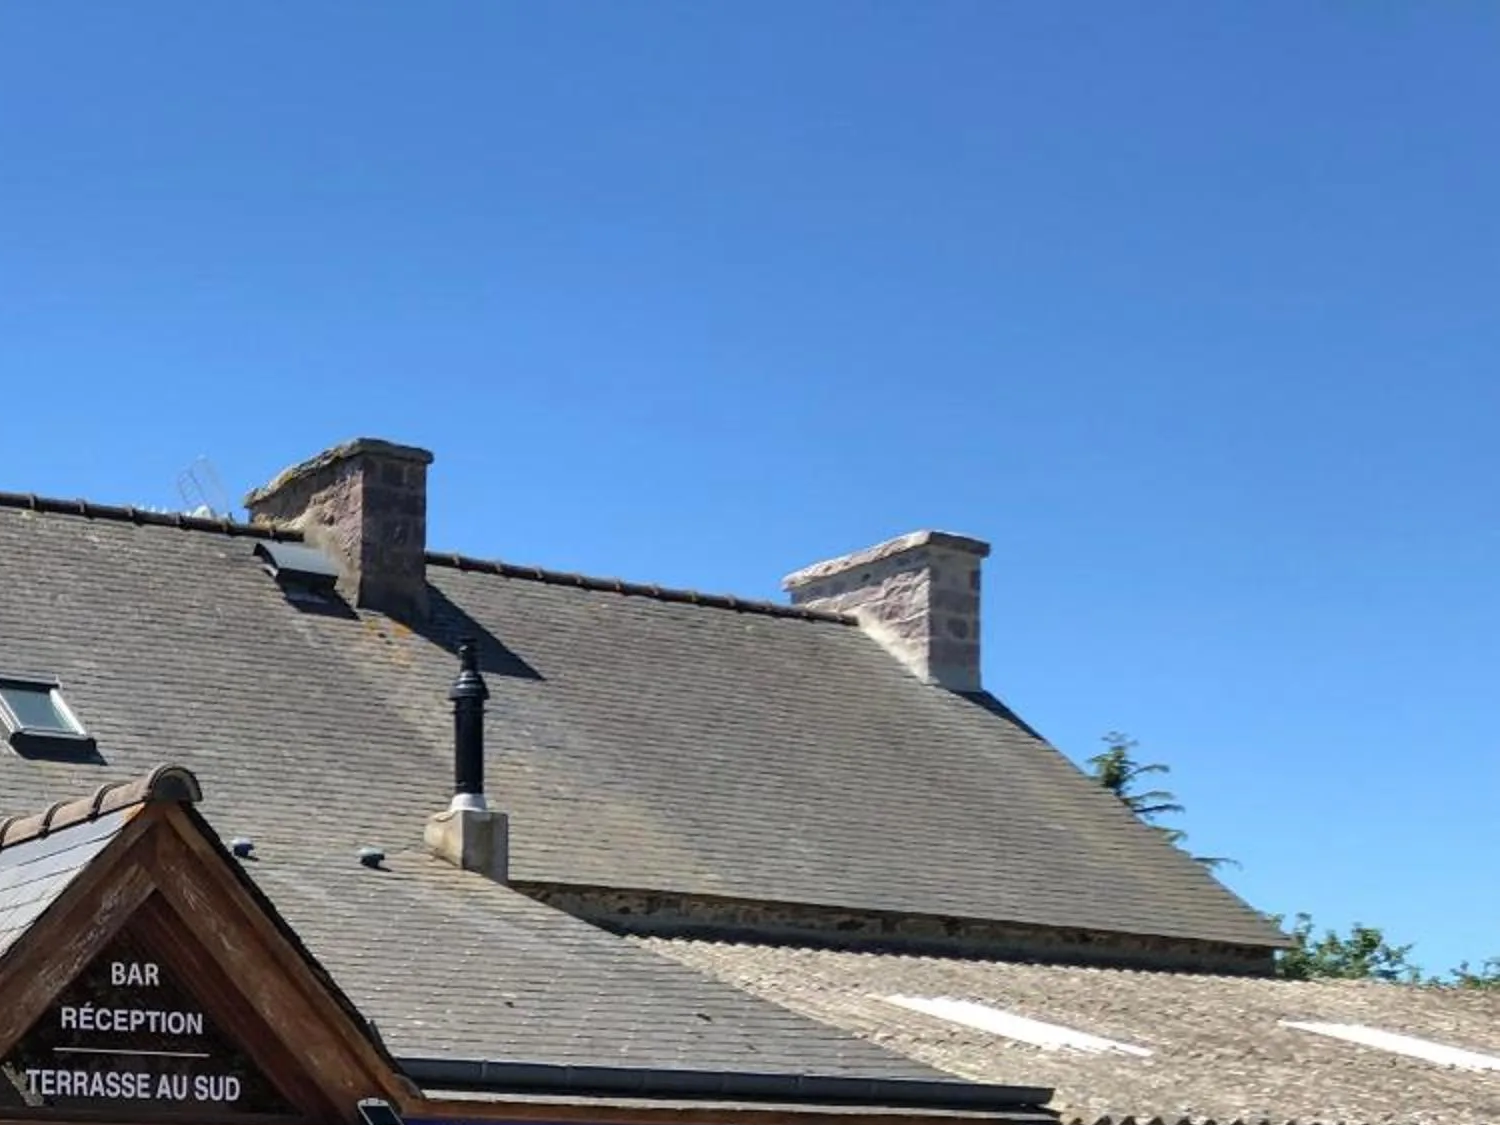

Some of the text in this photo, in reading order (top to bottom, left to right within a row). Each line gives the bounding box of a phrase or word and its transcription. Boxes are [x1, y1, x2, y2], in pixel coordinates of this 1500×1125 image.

[111, 961, 160, 986] BAR
[61, 1002, 203, 1035] RÉCEPTION
[26, 1068, 241, 1101] TERRASSE AU SUD
